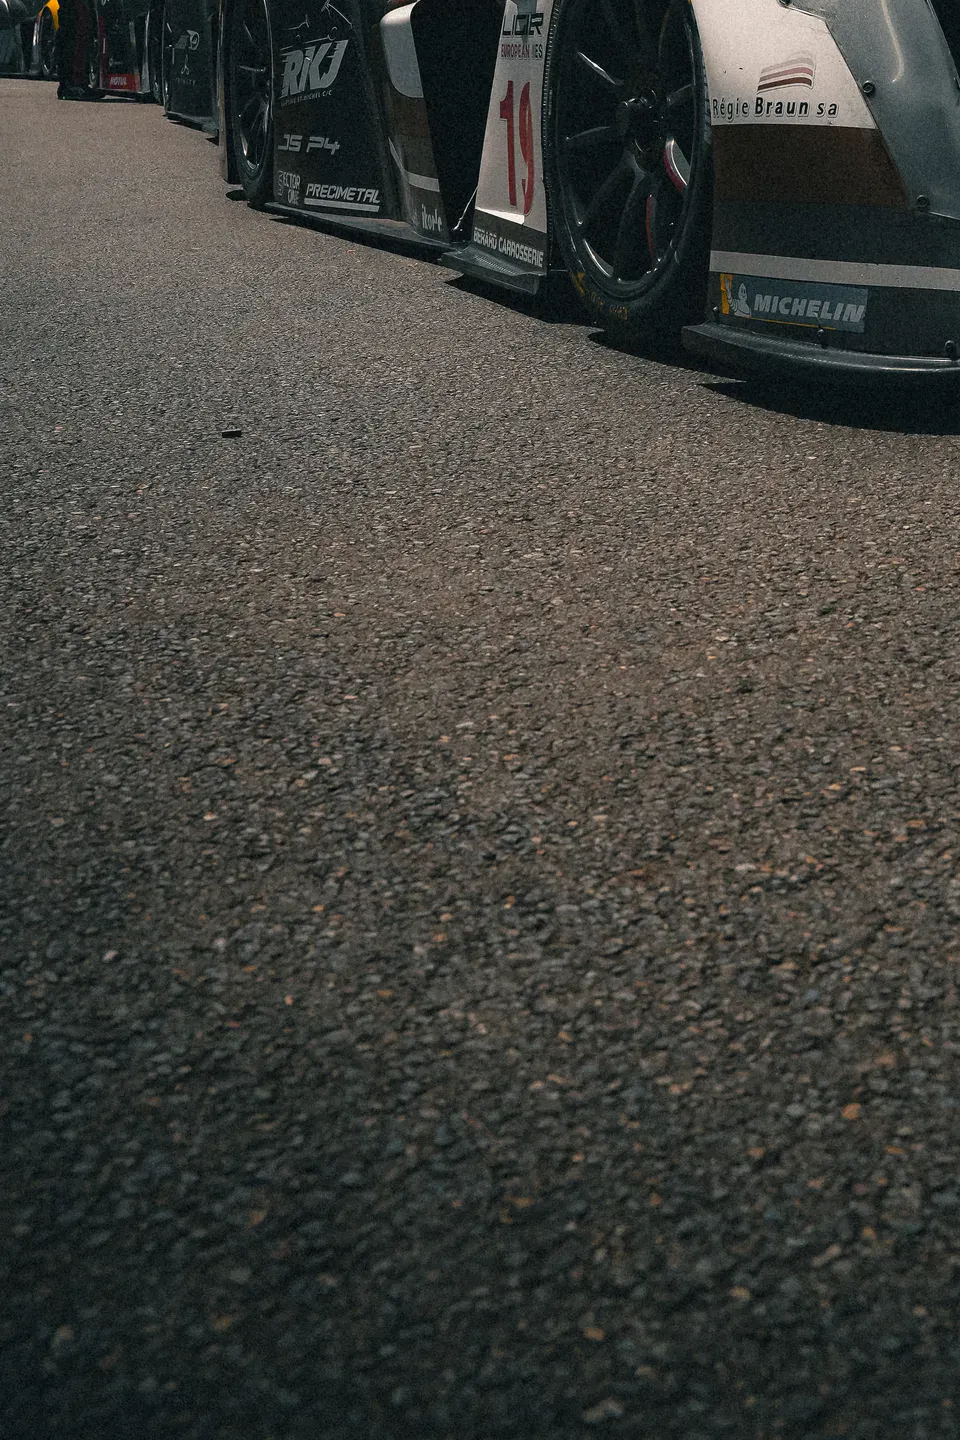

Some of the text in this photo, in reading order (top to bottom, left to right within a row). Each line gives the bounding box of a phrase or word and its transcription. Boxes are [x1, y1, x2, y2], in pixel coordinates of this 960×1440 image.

[280, 39, 349, 98] RKJ
[712, 96, 838, 121] Régie Braun sa
[277, 133, 341, 156] JS P4
[500, 80, 535, 216] 19
[306, 183, 381, 204] PRECIMETAL
[498, 236, 544, 269] CARROSSERIE
[754, 293, 867, 324] MICHELIN
